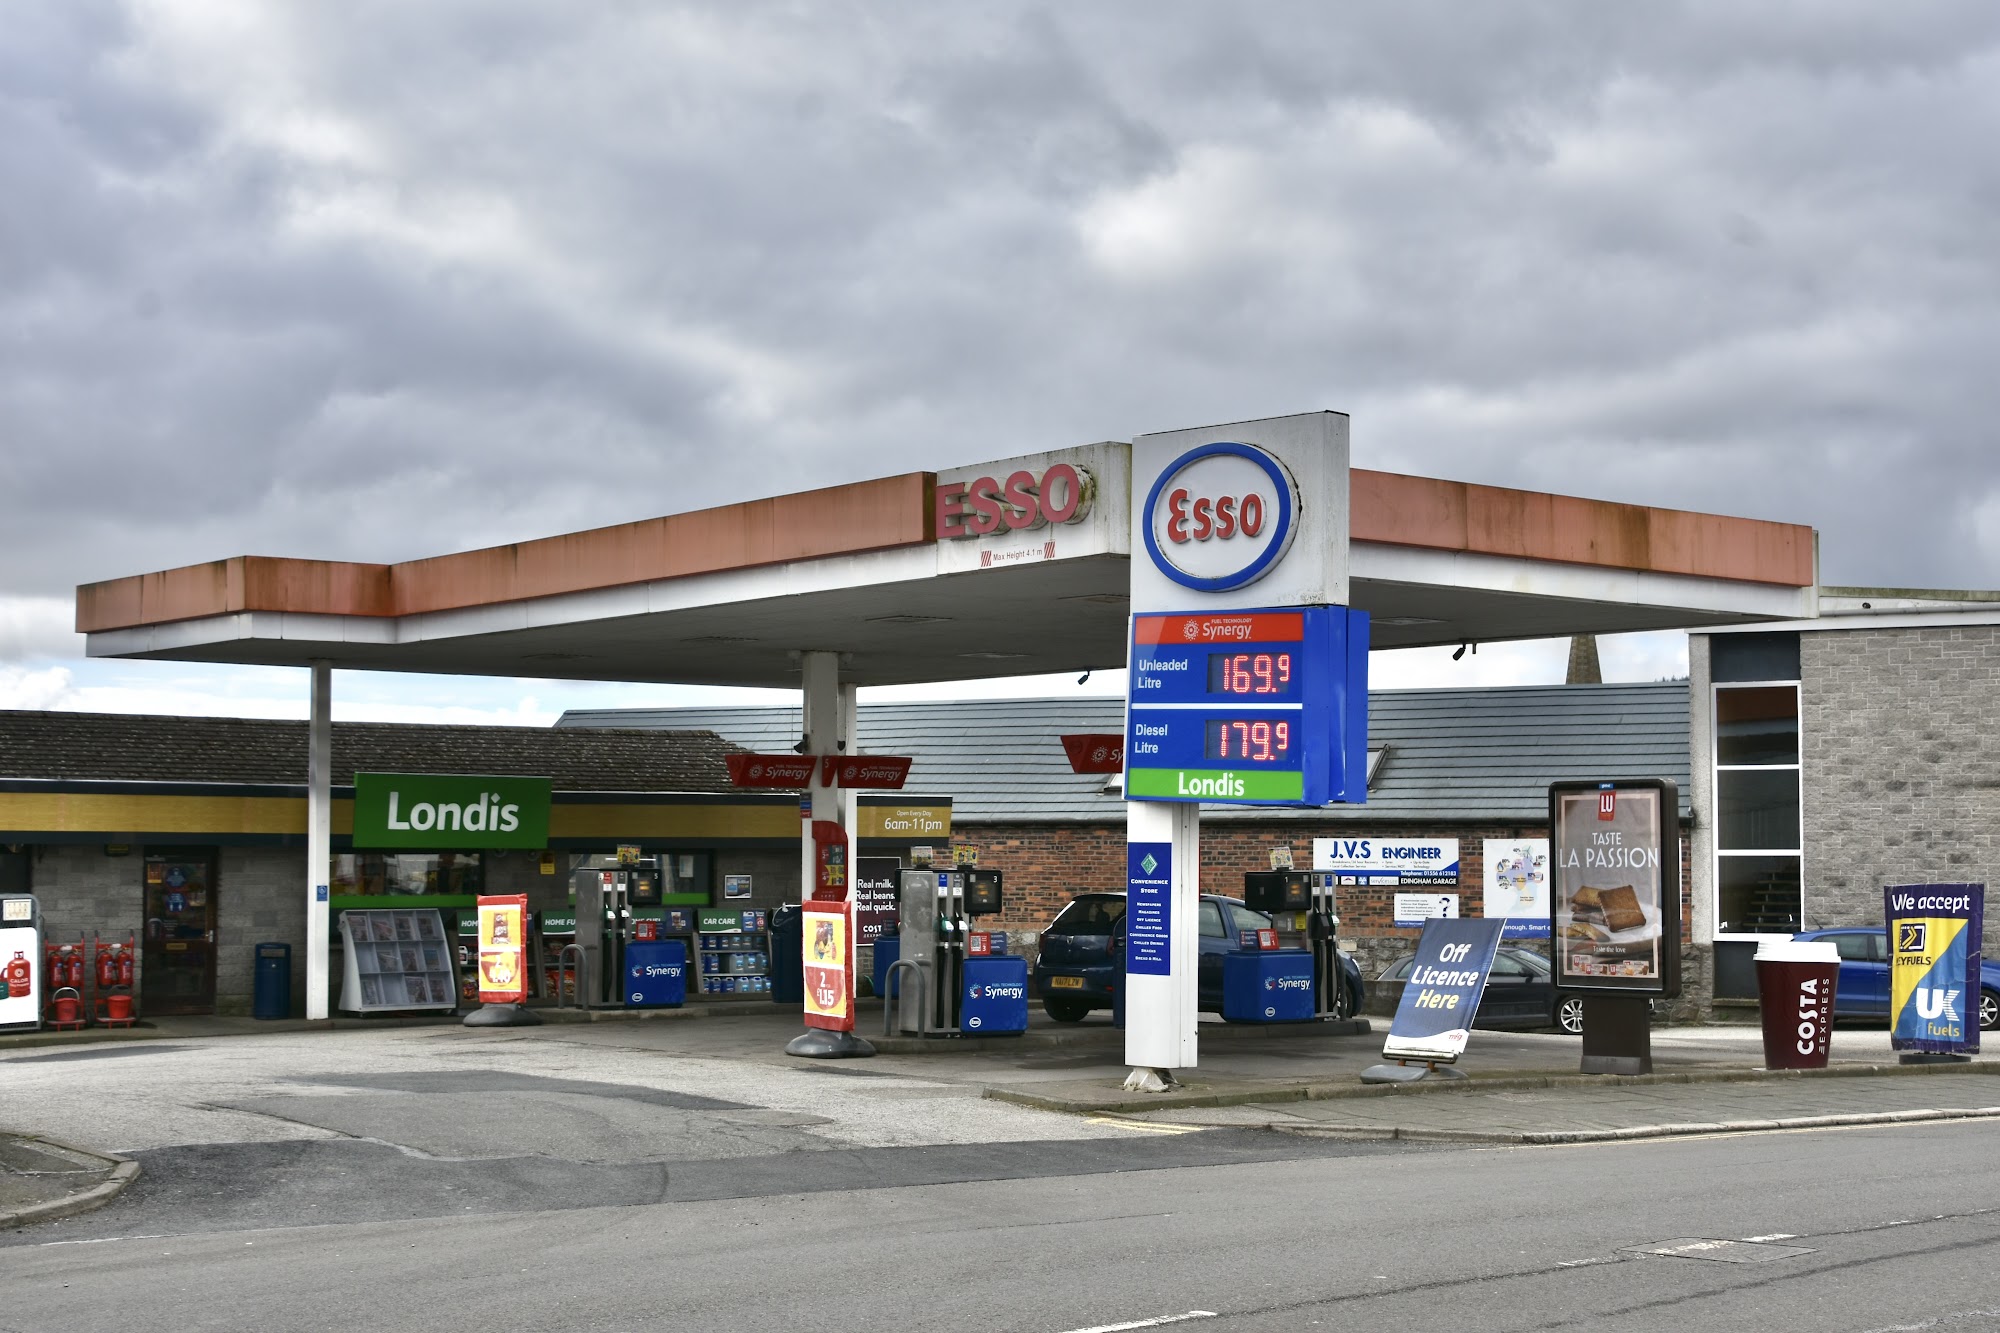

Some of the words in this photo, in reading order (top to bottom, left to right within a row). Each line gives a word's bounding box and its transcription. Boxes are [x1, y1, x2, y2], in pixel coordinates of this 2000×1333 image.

[936, 463, 1080, 539] ESSO
[993, 553, 1004, 561] Max
[1006, 550, 1025, 560] Height
[1026, 548, 1035, 557] 4.1
[1202, 622, 1251, 640] Synergy
[1139, 659, 1188, 671] Unleaded
[1223, 654, 1290, 693] 169.9
[1138, 677, 1162, 689] Litre
[1135, 723, 1168, 736] Diesel
[1134, 741, 1159, 754] Litre
[1220, 722, 1288, 760] 179.9
[765, 766, 809, 780] Synergy
[859, 767, 901, 781] Synergy
[1178, 771, 1245, 797] Londis
[1601, 795, 1613, 812] LU
[388, 791, 519, 832] Londis
[897, 810, 909, 818] Open
[884, 818, 942, 832] 6am-11pm
[1592, 832, 1621, 845] TASTE
[1330, 841, 1371, 859] J.V.S
[1382, 847, 1441, 859] ENGINEER
[1560, 848, 1580, 867] LA
[1586, 847, 1658, 868] PASSION
[858, 878, 873, 888] Real
[875, 878, 894, 888] milk.
[856, 890, 871, 899] Real
[856, 901, 872, 911] Real
[873, 901, 896, 914] quick.
[1892, 893, 1915, 911] We
[1917, 894, 1970, 914] accept
[863, 925, 881, 933] COST
[1439, 943, 1472, 962] Off
[646, 966, 681, 977] Synergy
[820, 971, 825, 987] 2
[1410, 965, 1479, 986] Licence
[1278, 978, 1310, 990] Synergy
[985, 985, 1023, 999] Synergy
[1415, 989, 1459, 1009] Here
[1819, 978, 1830, 1043] EXPRESS
[1916, 987, 1960, 1021] UK
[1797, 978, 1818, 1055] COSTA
[1927, 1022, 1960, 1037] fuels
